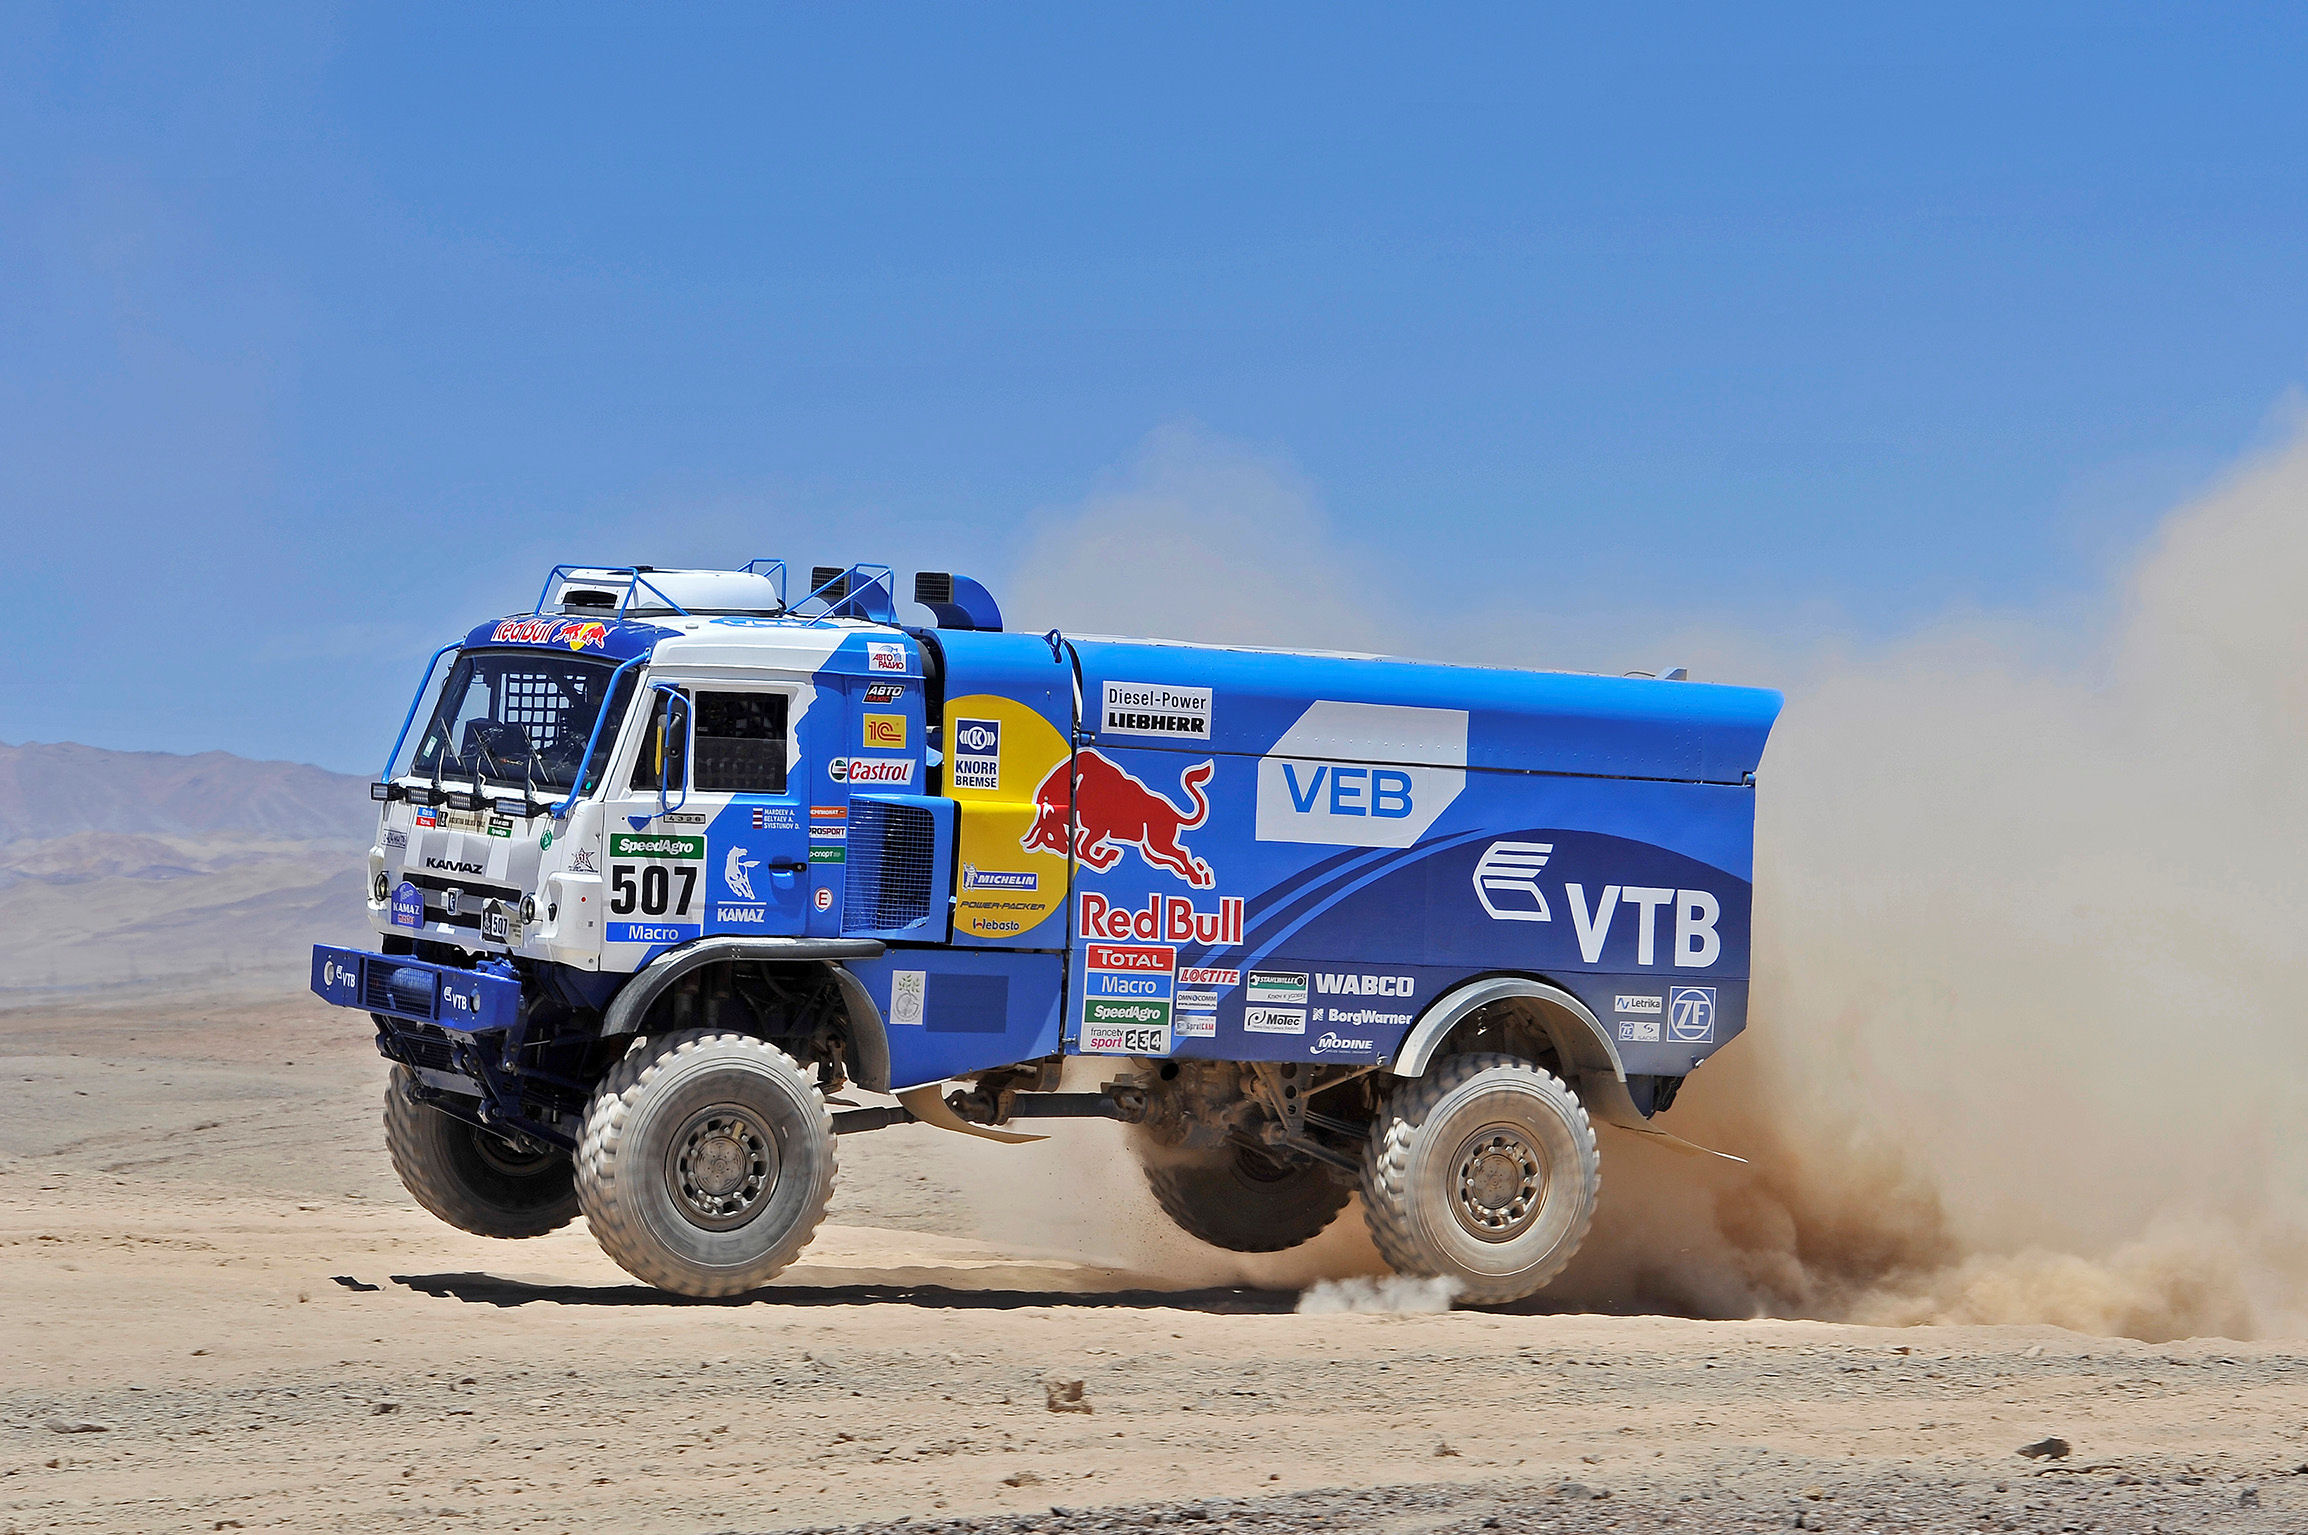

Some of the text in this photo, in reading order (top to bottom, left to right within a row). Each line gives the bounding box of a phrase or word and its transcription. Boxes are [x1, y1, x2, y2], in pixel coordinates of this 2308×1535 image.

[868, 686, 903, 696] АВТО
[1109, 688, 1206, 709] Diesel-Power
[1108, 712, 1205, 733] LIEBHERR
[849, 761, 909, 781] Castrol
[956, 760, 997, 775] KNORR
[956, 776, 997, 788] BREMSE
[1281, 763, 1414, 819] VEB
[619, 838, 694, 855] SpeedAgro
[426, 857, 483, 875] KAMAZ
[977, 874, 1035, 885] MICHELIN
[610, 865, 697, 915] 507
[818, 891, 828, 906] E
[393, 902, 420, 915] KAMAZ
[717, 908, 765, 923] KAMAZ
[492, 915, 508, 935] 507
[973, 918, 1020, 931] Webasto
[1081, 893, 1243, 944] Red Bull
[1564, 882, 1721, 968] VTB
[628, 925, 679, 940] Macro
[1097, 949, 1164, 968] TOTAL
[342, 972, 356, 988] VTB
[1102, 975, 1157, 994] Macro
[1180, 969, 1239, 983] LOCTITE
[1315, 973, 1415, 998] WABCO
[452, 993, 467, 1010] VTB
[1631, 998, 1661, 1008] Letrika
[1094, 1005, 1161, 1021] SpeedAgro
[1328, 1009, 1413, 1026] BorgWarner
[1675, 999, 1709, 1029] ZF
[1090, 1037, 1123, 1049] sport
[1318, 1037, 1374, 1050] MODINE
